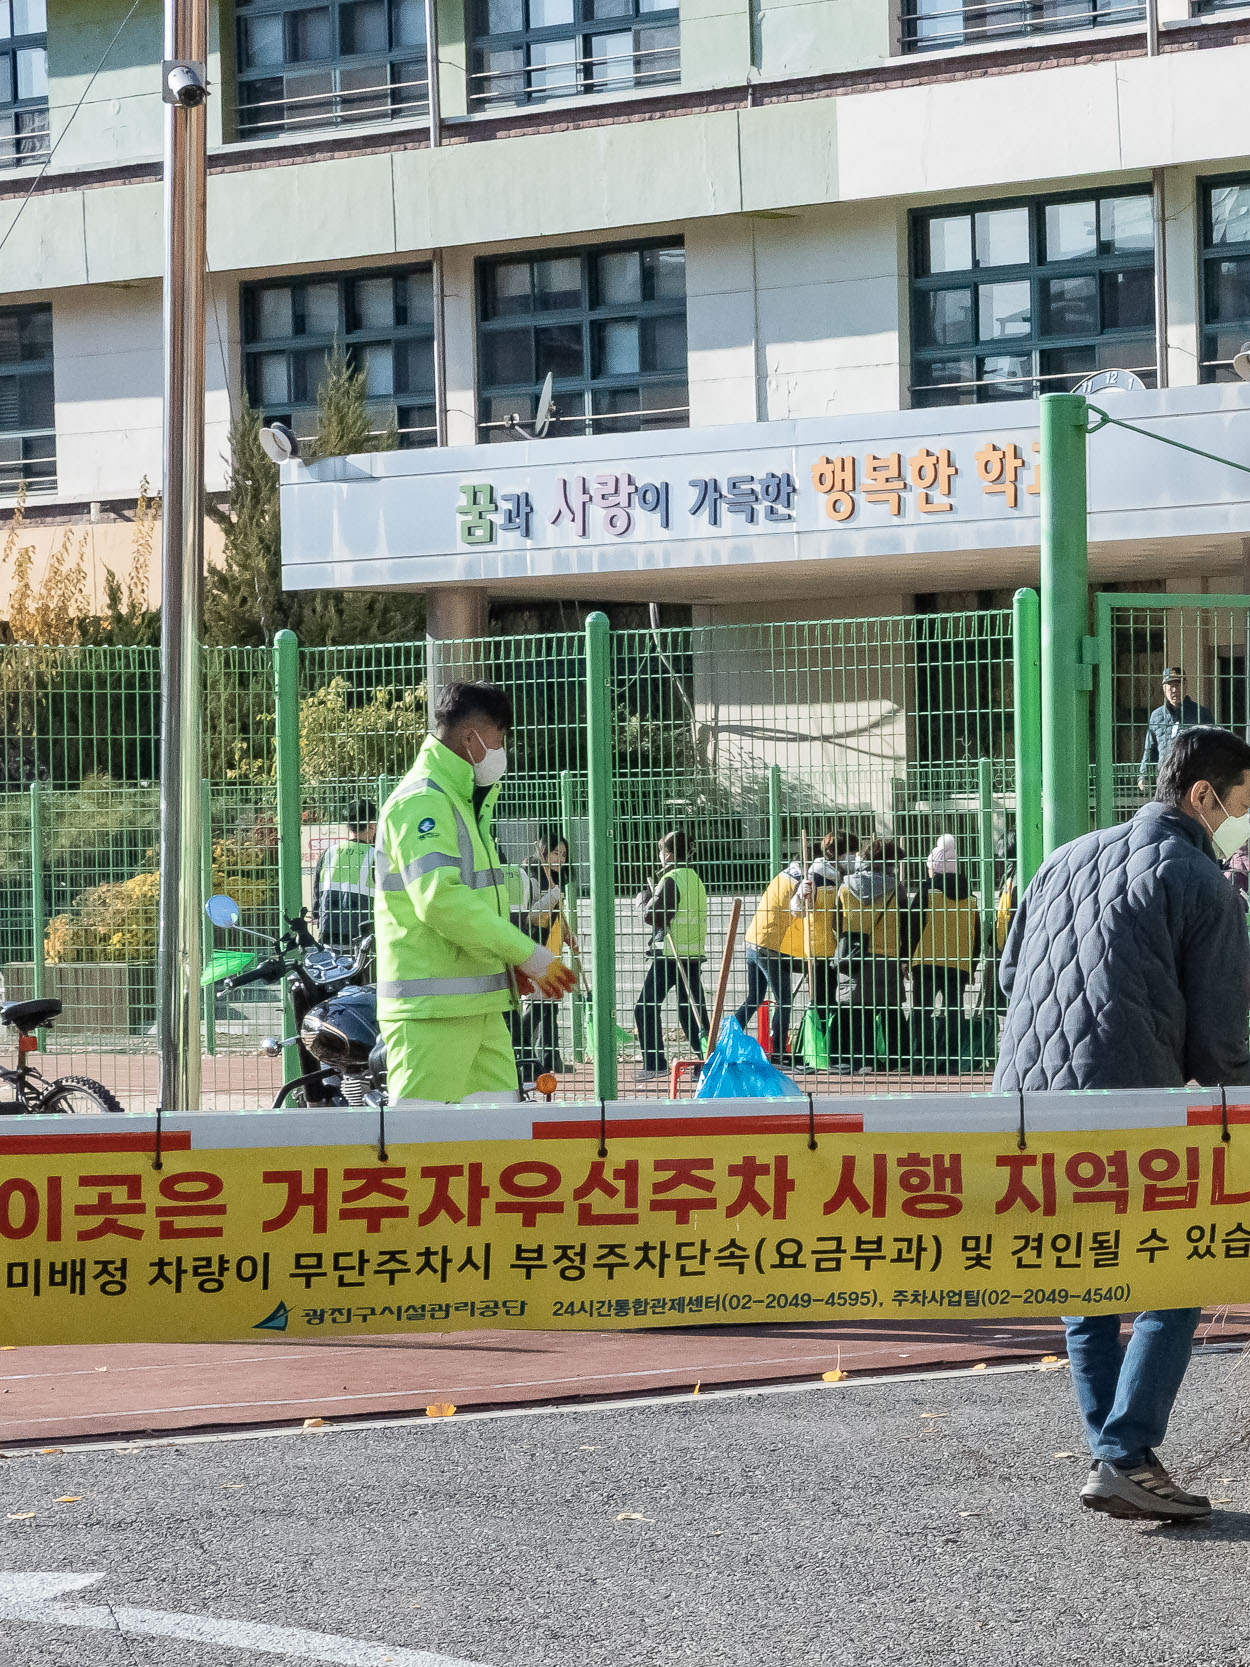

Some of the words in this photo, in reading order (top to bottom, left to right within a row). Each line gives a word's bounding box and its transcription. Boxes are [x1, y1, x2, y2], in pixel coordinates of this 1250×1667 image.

[1105, 371, 1119, 384] 12
[456, 484, 533, 545] 꿈과
[550, 473, 669, 537] 사랑이
[688, 472, 797, 526] 가득한
[810, 448, 959, 521] 행복한
[0, 1171, 227, 1242] 이곳은
[261, 1154, 796, 1235] 거주자우선주차
[822, 1153, 964, 1220] 시행
[6, 1257, 128, 1296] 미배정
[148, 1252, 270, 1293] 차량이
[289, 1242, 491, 1289] 무단주차시
[961, 1233, 993, 1271] 및
[1011, 1229, 1121, 1270] 견인될
[1135, 1228, 1169, 1263] 수
[300, 1299, 528, 1326] 광진구시설관리공단
